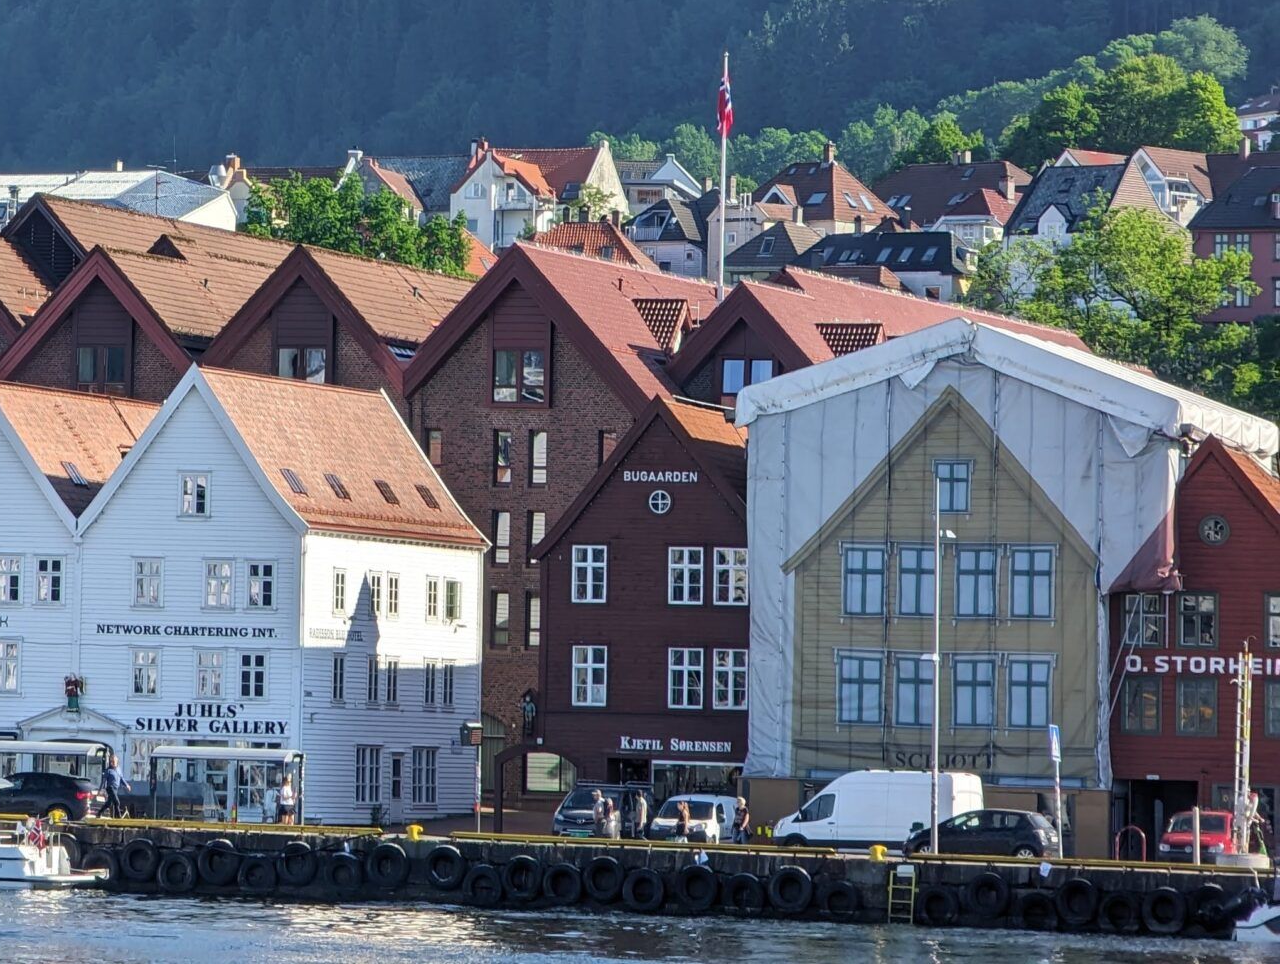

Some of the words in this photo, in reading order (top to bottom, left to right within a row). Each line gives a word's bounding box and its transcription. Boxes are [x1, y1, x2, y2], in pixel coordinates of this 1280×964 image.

[623, 471, 698, 483] BUGAARDEN
[96, 624, 161, 635] NETWORK
[163, 625, 249, 637] CHARTERING
[252, 627, 277, 638] INT.
[1125, 655, 1148, 673] O.
[1154, 656, 1280, 676] STORHEI
[135, 717, 199, 732] SILVER
[209, 719, 288, 735] GALLERY
